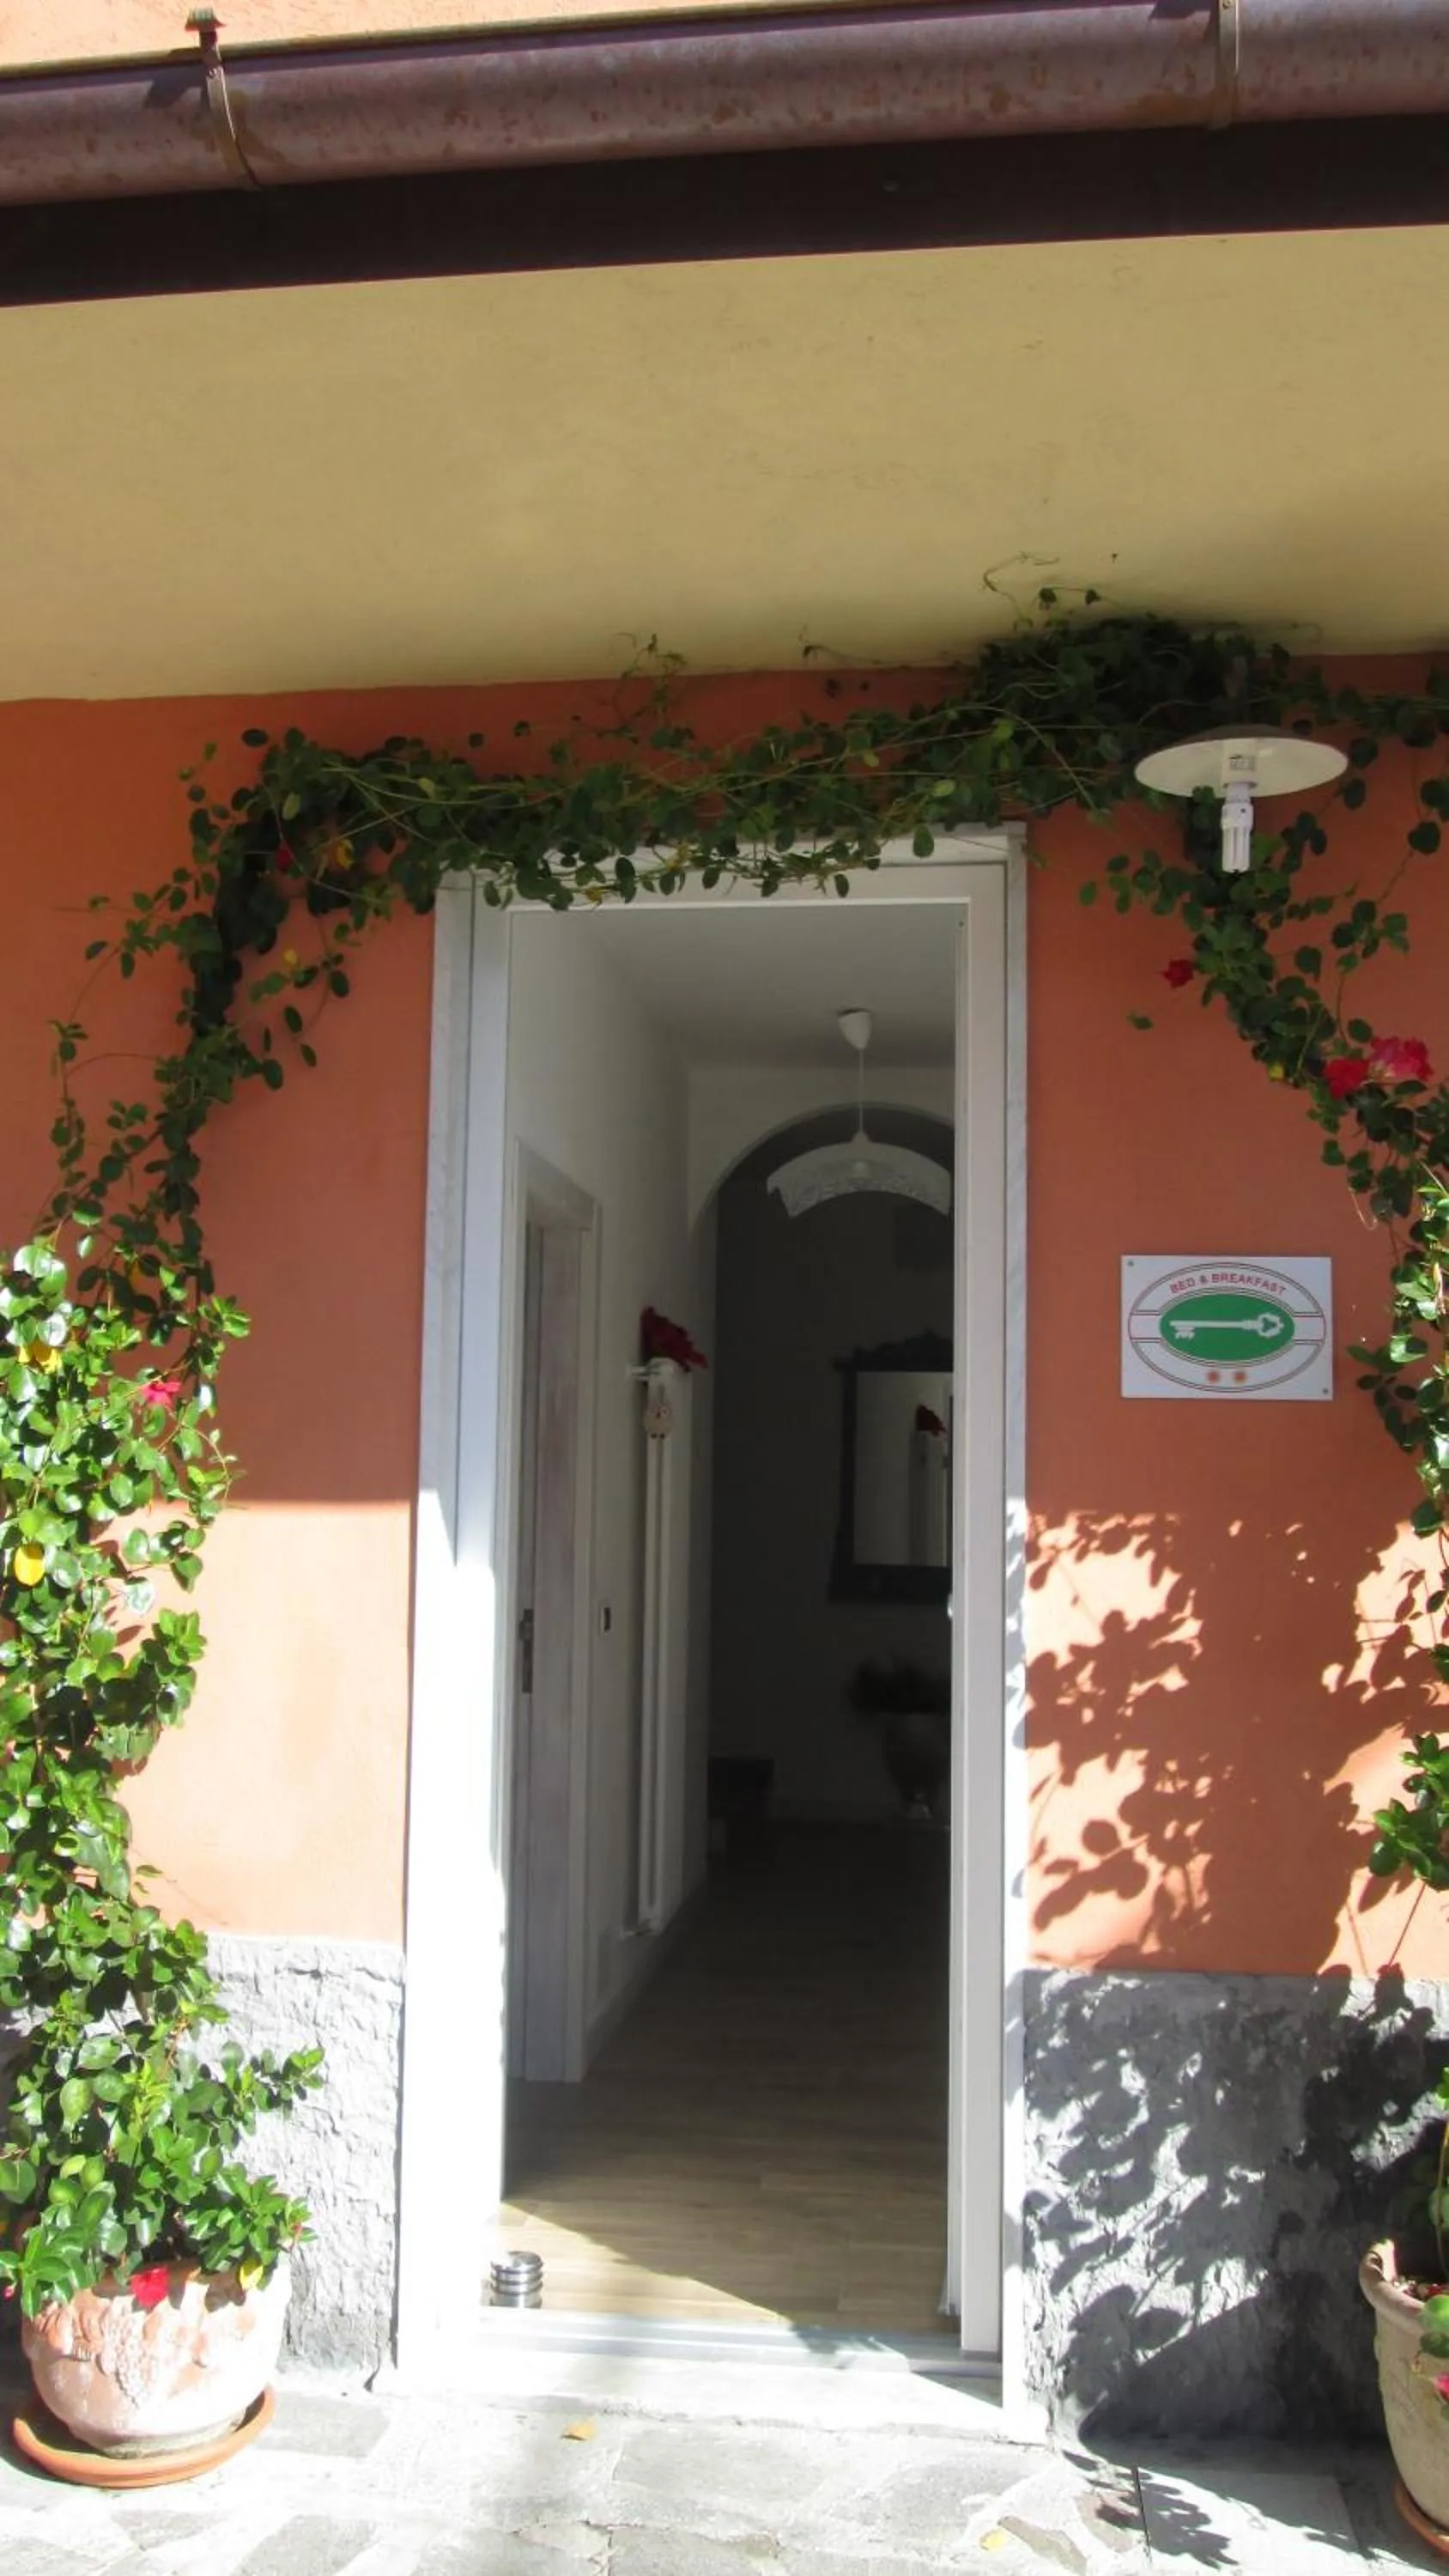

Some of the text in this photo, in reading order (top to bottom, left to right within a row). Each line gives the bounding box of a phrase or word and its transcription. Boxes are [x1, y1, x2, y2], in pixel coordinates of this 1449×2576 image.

[1169, 1273, 1286, 1295] BED & BREAKFAST
